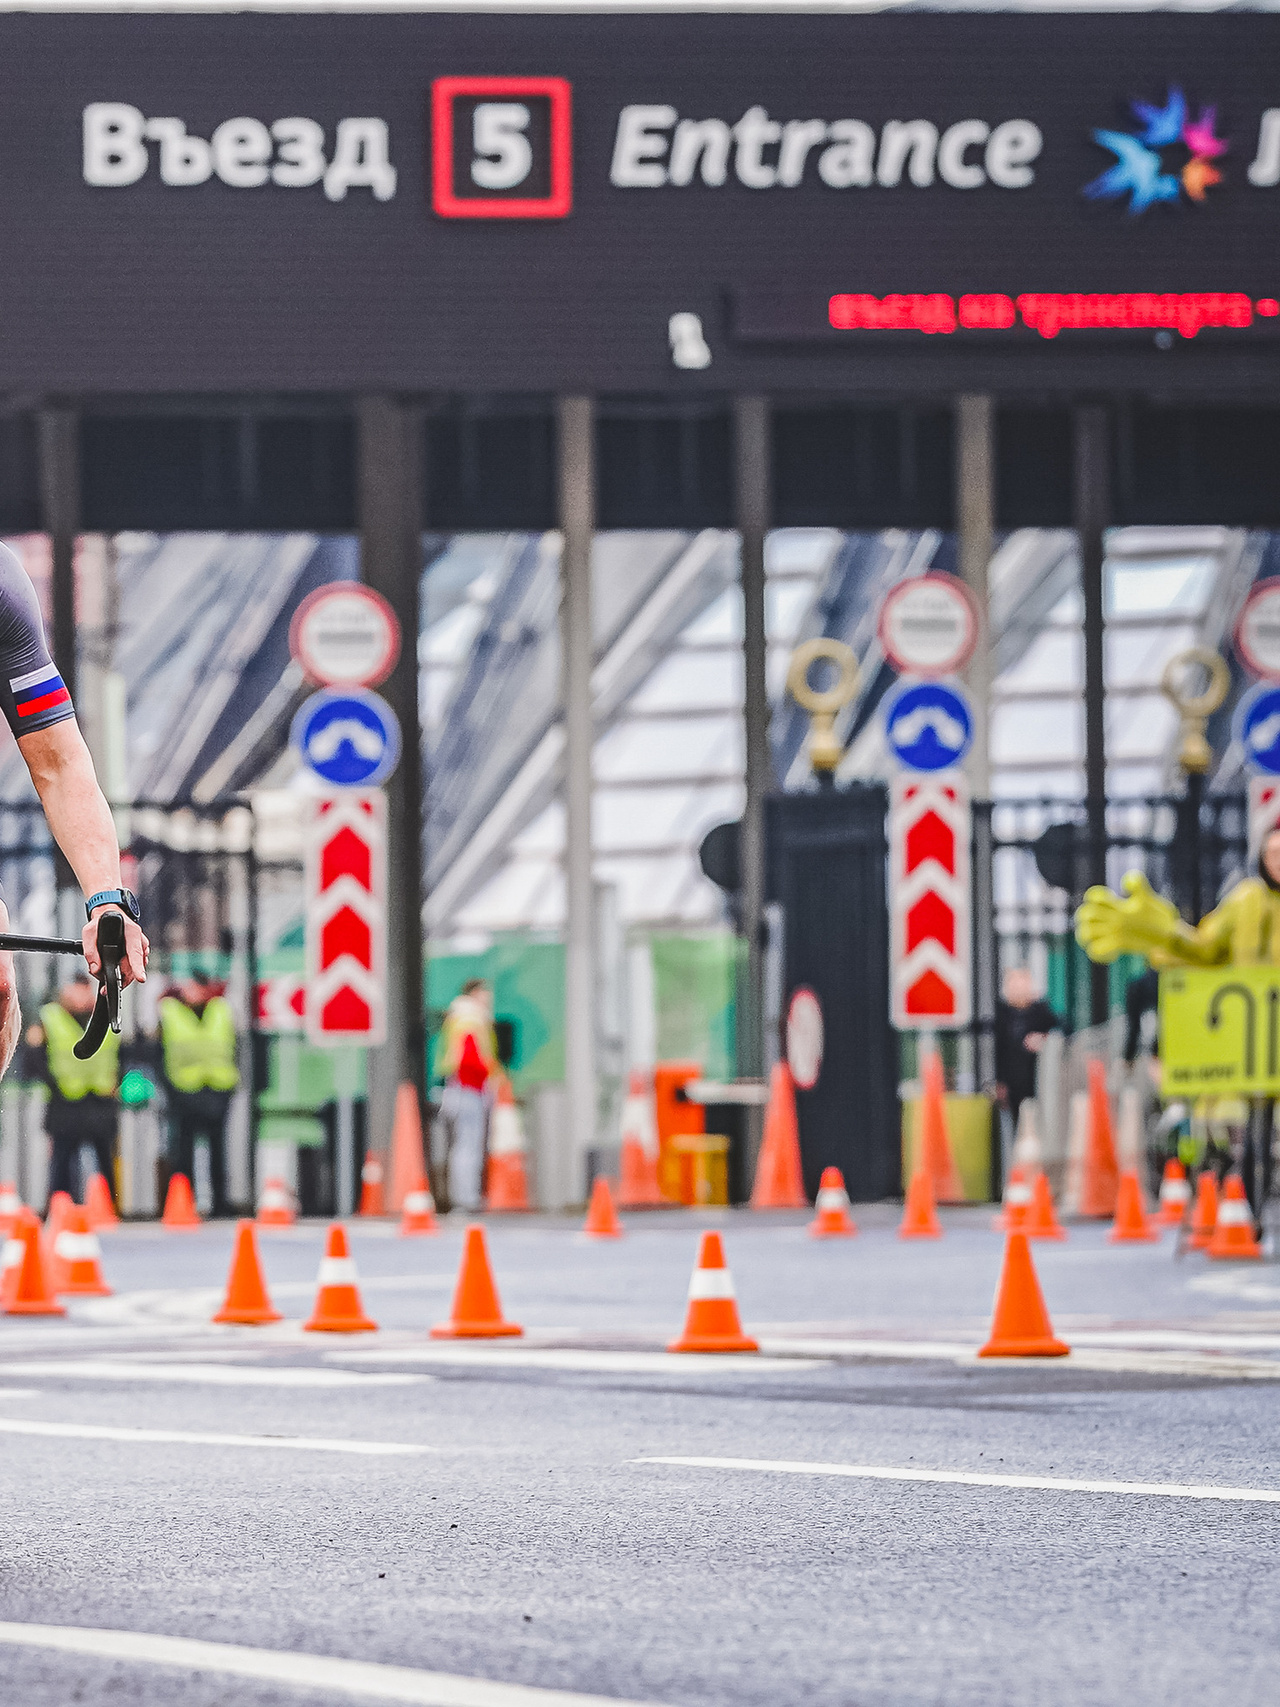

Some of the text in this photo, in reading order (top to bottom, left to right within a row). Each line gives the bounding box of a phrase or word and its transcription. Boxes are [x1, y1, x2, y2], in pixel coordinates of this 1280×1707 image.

[82, 102, 397, 201] Въезд
[471, 103, 533, 189] 5
[610, 104, 1043, 188] Entrance
